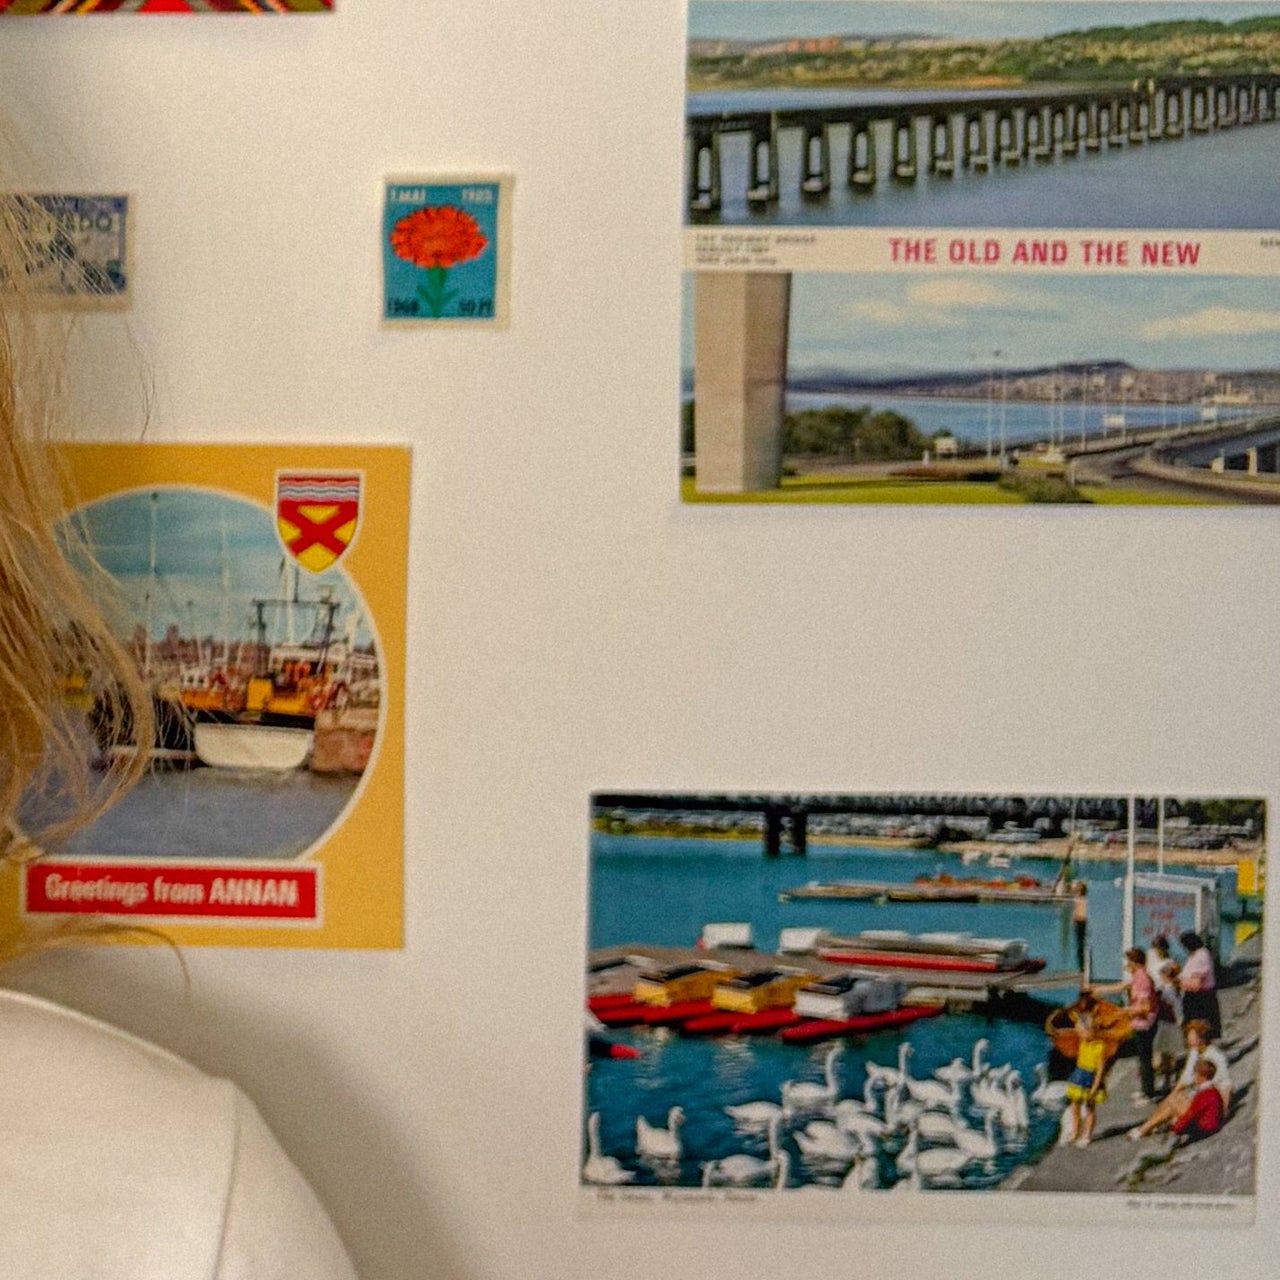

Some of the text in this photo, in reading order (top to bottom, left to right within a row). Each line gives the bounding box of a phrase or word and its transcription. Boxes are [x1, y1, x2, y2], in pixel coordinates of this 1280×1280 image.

[888, 237, 1202, 266] THE OLD AND THE NEW
[44, 872, 301, 907] Greetings from ANNAN
